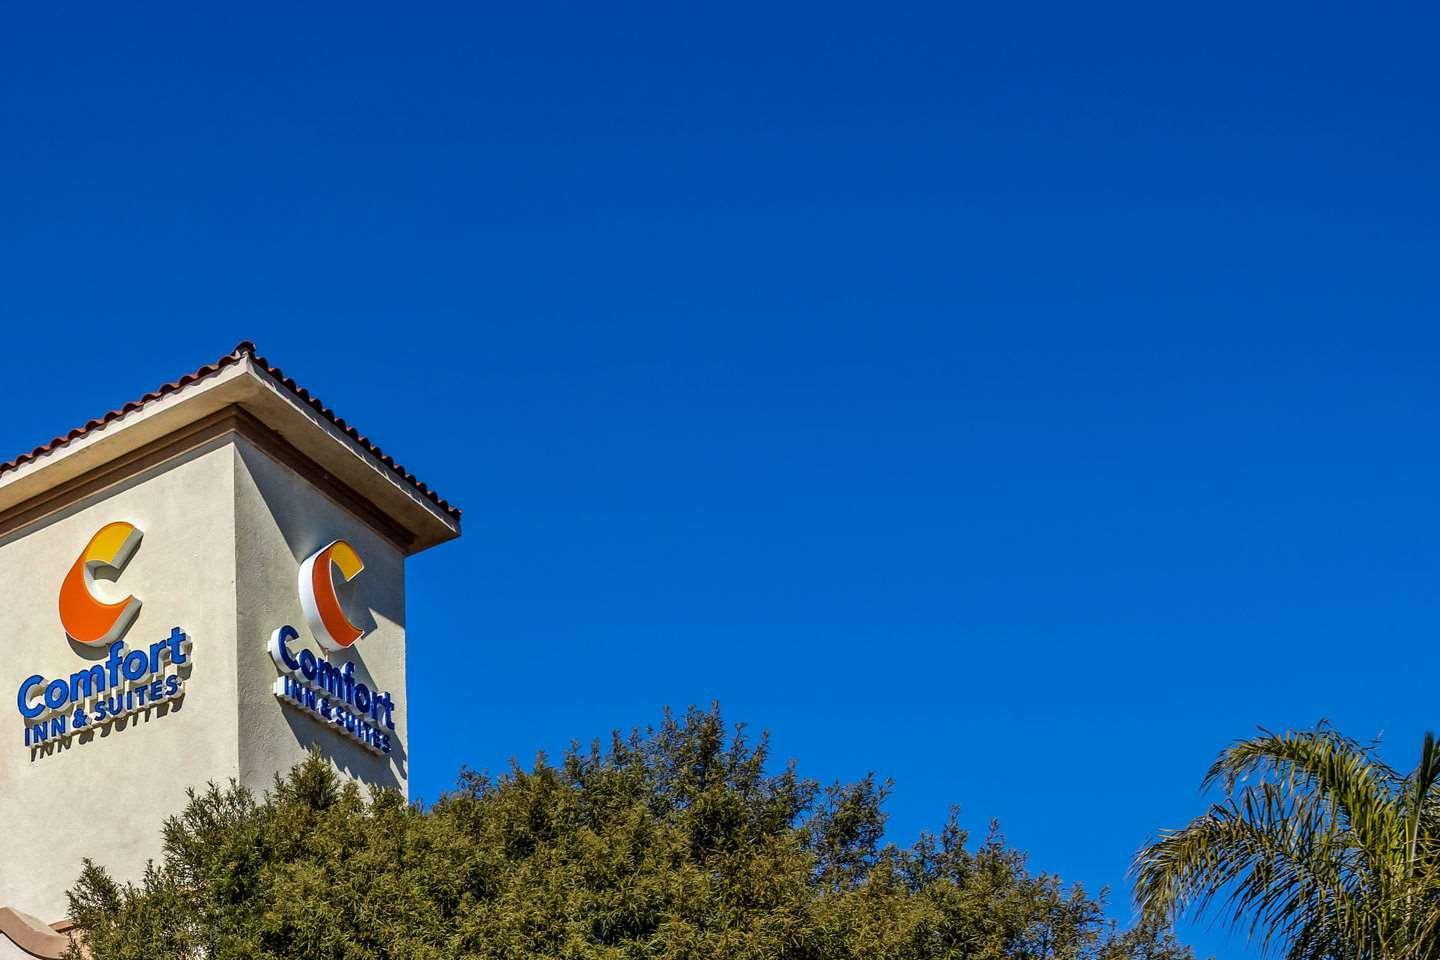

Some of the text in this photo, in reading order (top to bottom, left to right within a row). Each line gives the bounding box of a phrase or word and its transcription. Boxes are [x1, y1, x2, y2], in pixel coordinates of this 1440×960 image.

[17, 626, 187, 719] Comfort
[25, 674, 178, 747] INN & SUITES
[277, 624, 395, 730] Comfort
[283, 675, 316, 711] INN
[335, 706, 392, 754] SUITES
